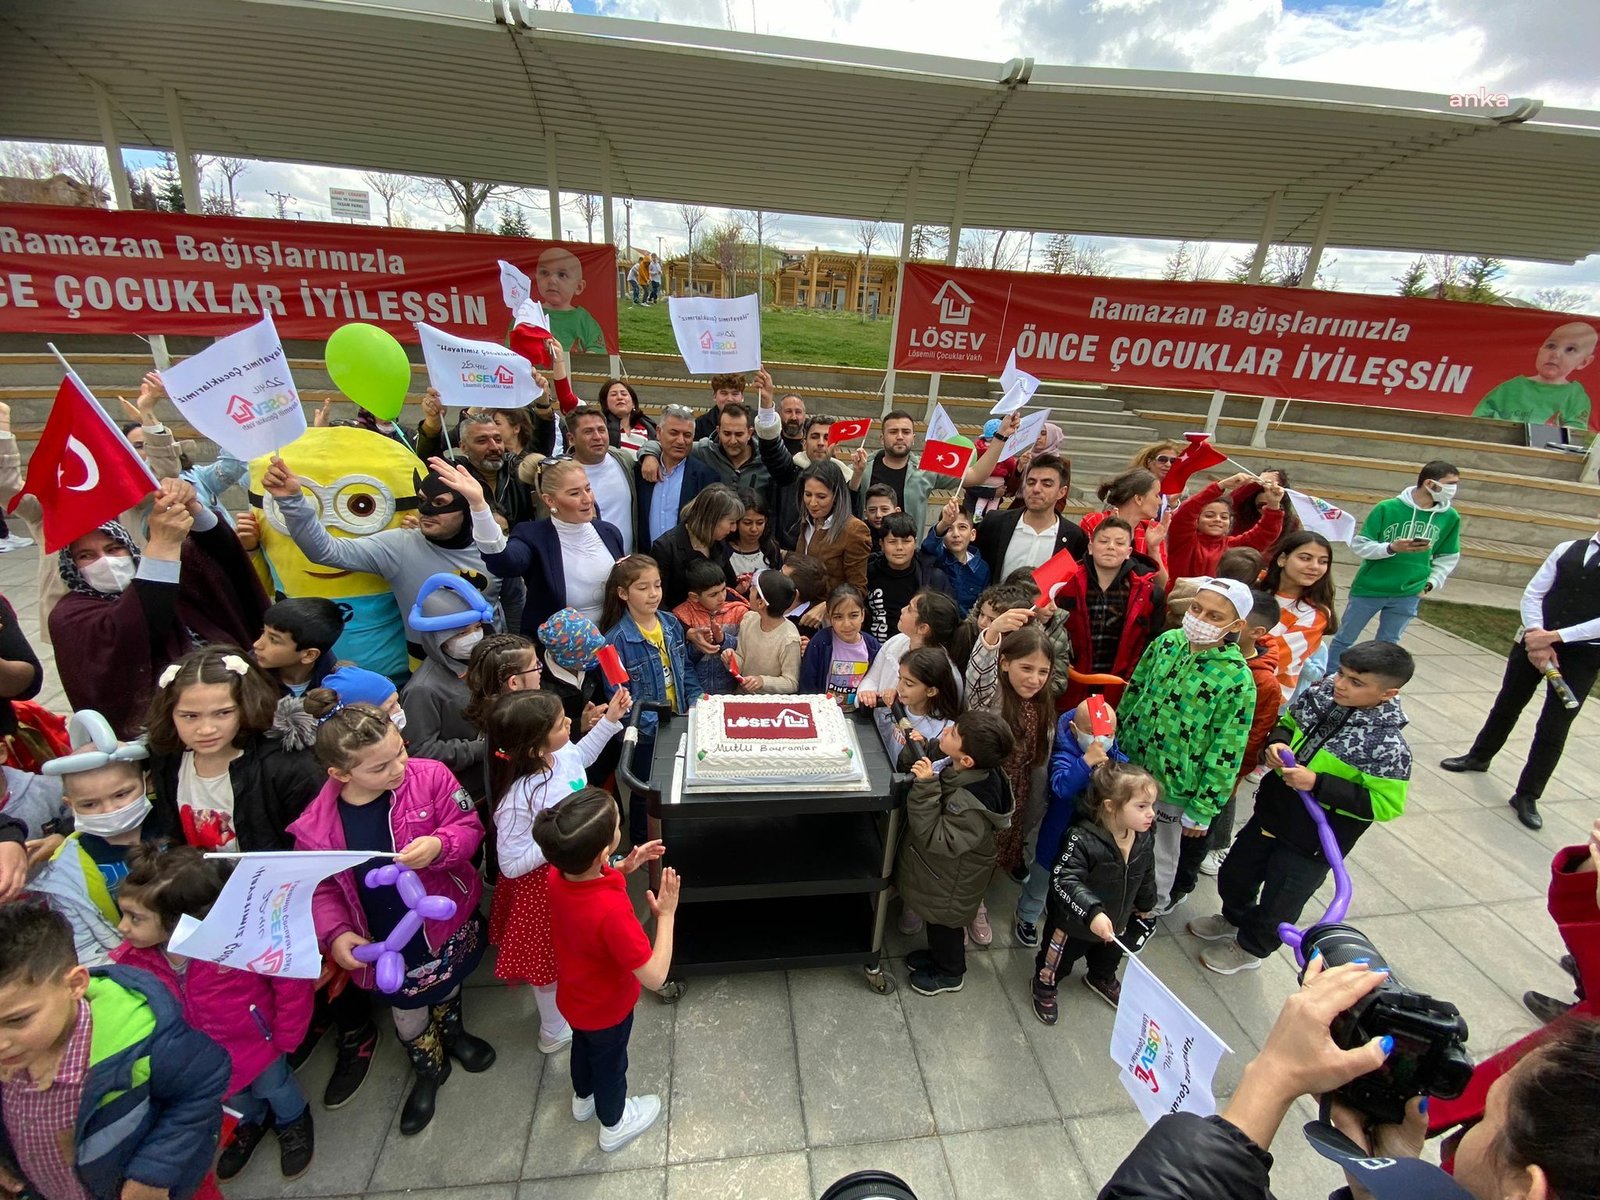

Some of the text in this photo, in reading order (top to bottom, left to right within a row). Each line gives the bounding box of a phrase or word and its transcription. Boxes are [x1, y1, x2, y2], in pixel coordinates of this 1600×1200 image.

[0, 225, 406, 275] Ramazan Bağışlarınızla
[54, 274, 288, 319] ÇOCUKLAR
[1089, 296, 1411, 342] Ramazan Bağışlarınızla
[908, 350, 983, 362] Lösemili Çocuklar Vakfı
[909, 326, 987, 351] LÖSEV
[1016, 323, 1473, 396] ÖNCE ÇOCUKLAR İYİLEŞSİN
[727, 716, 783, 728] LÖSEV
